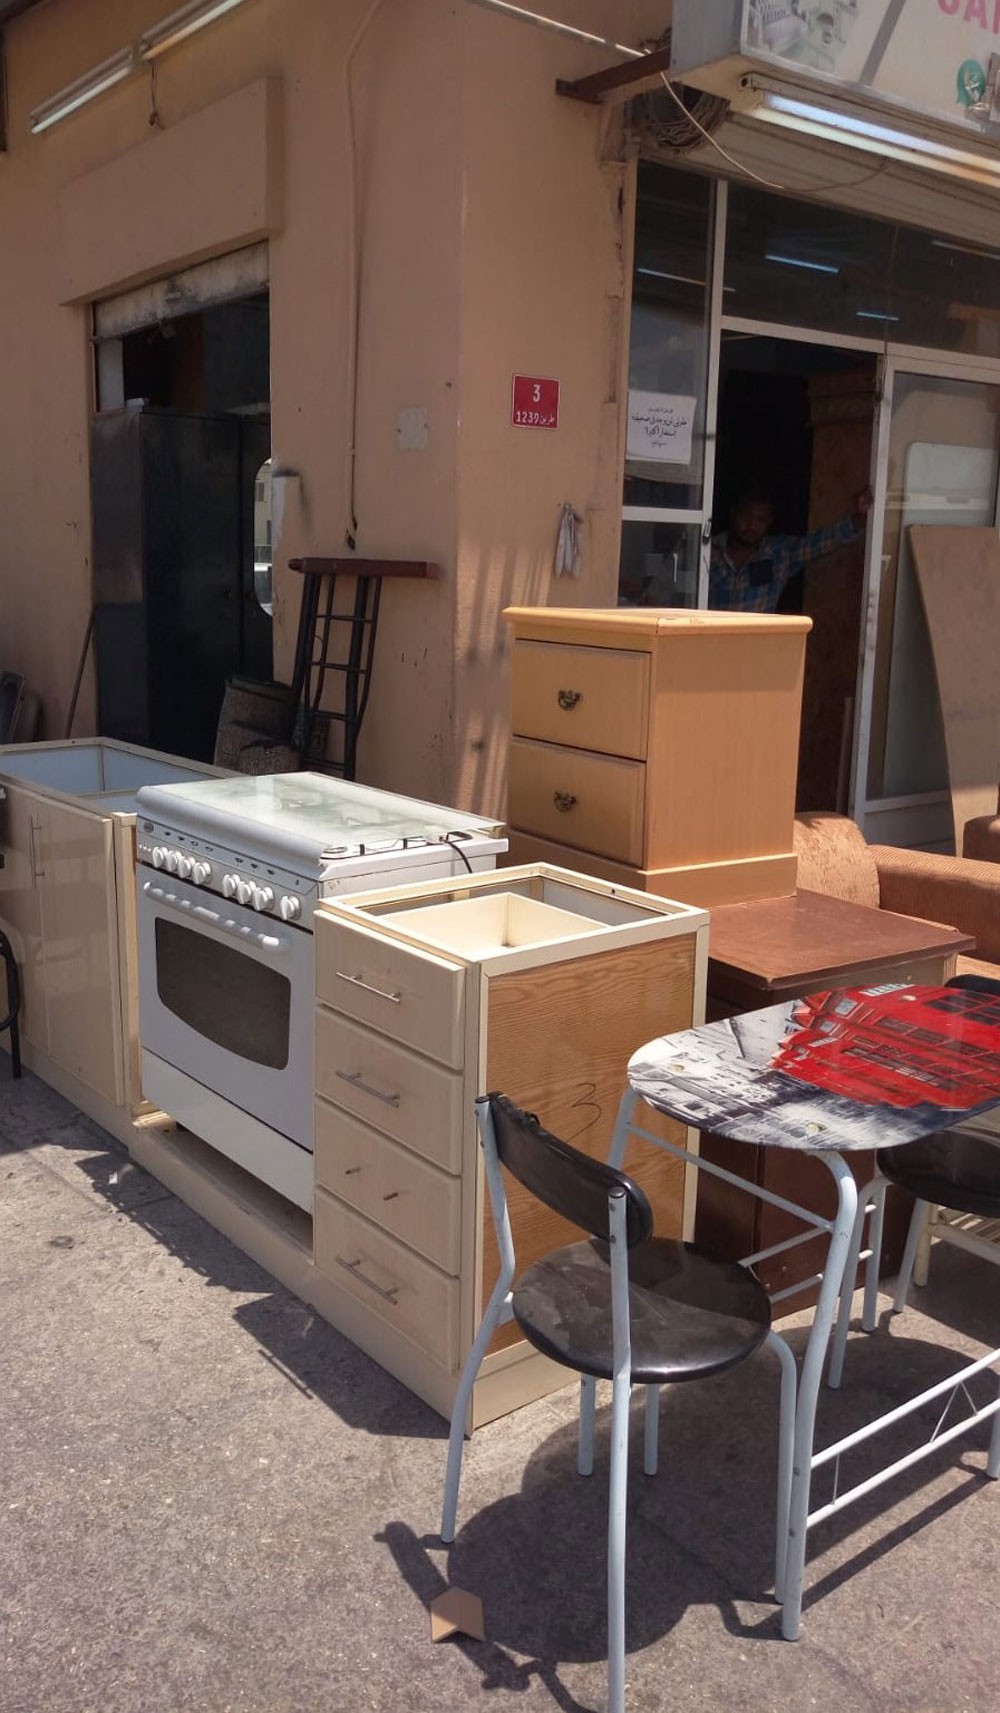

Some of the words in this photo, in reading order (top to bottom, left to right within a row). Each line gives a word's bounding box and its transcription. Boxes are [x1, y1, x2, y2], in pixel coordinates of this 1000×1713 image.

[532, 384, 541, 402] 3
[515, 411, 539, 424] 1239
[567, 1082, 602, 1141] 3
